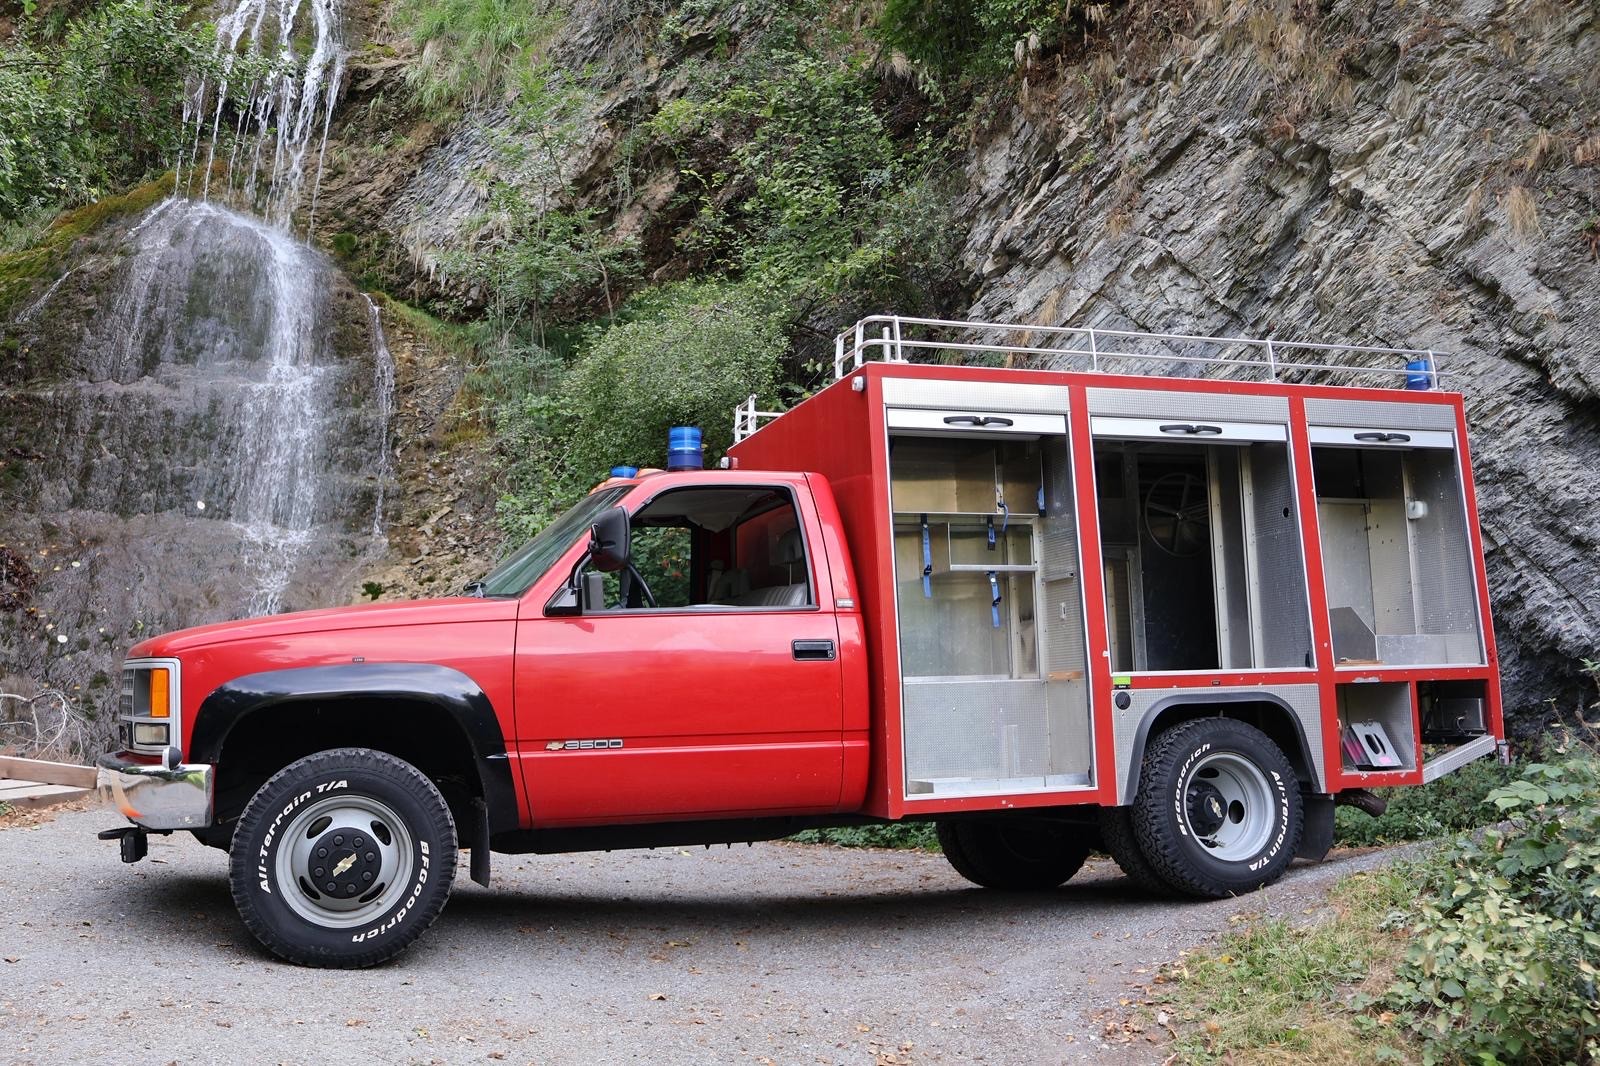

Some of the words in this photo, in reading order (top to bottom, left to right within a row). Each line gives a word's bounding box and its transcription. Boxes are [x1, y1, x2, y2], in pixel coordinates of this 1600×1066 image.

[565, 739, 623, 750] 3500
[1174, 743, 1211, 836] BFGoodrich
[258, 791, 312, 894] All-Terrain
[316, 779, 348, 794] T/A
[1270, 770, 1289, 857] All-Terrain
[352, 840, 430, 943] BFGoodrich
[1249, 857, 1270, 872] T/A
